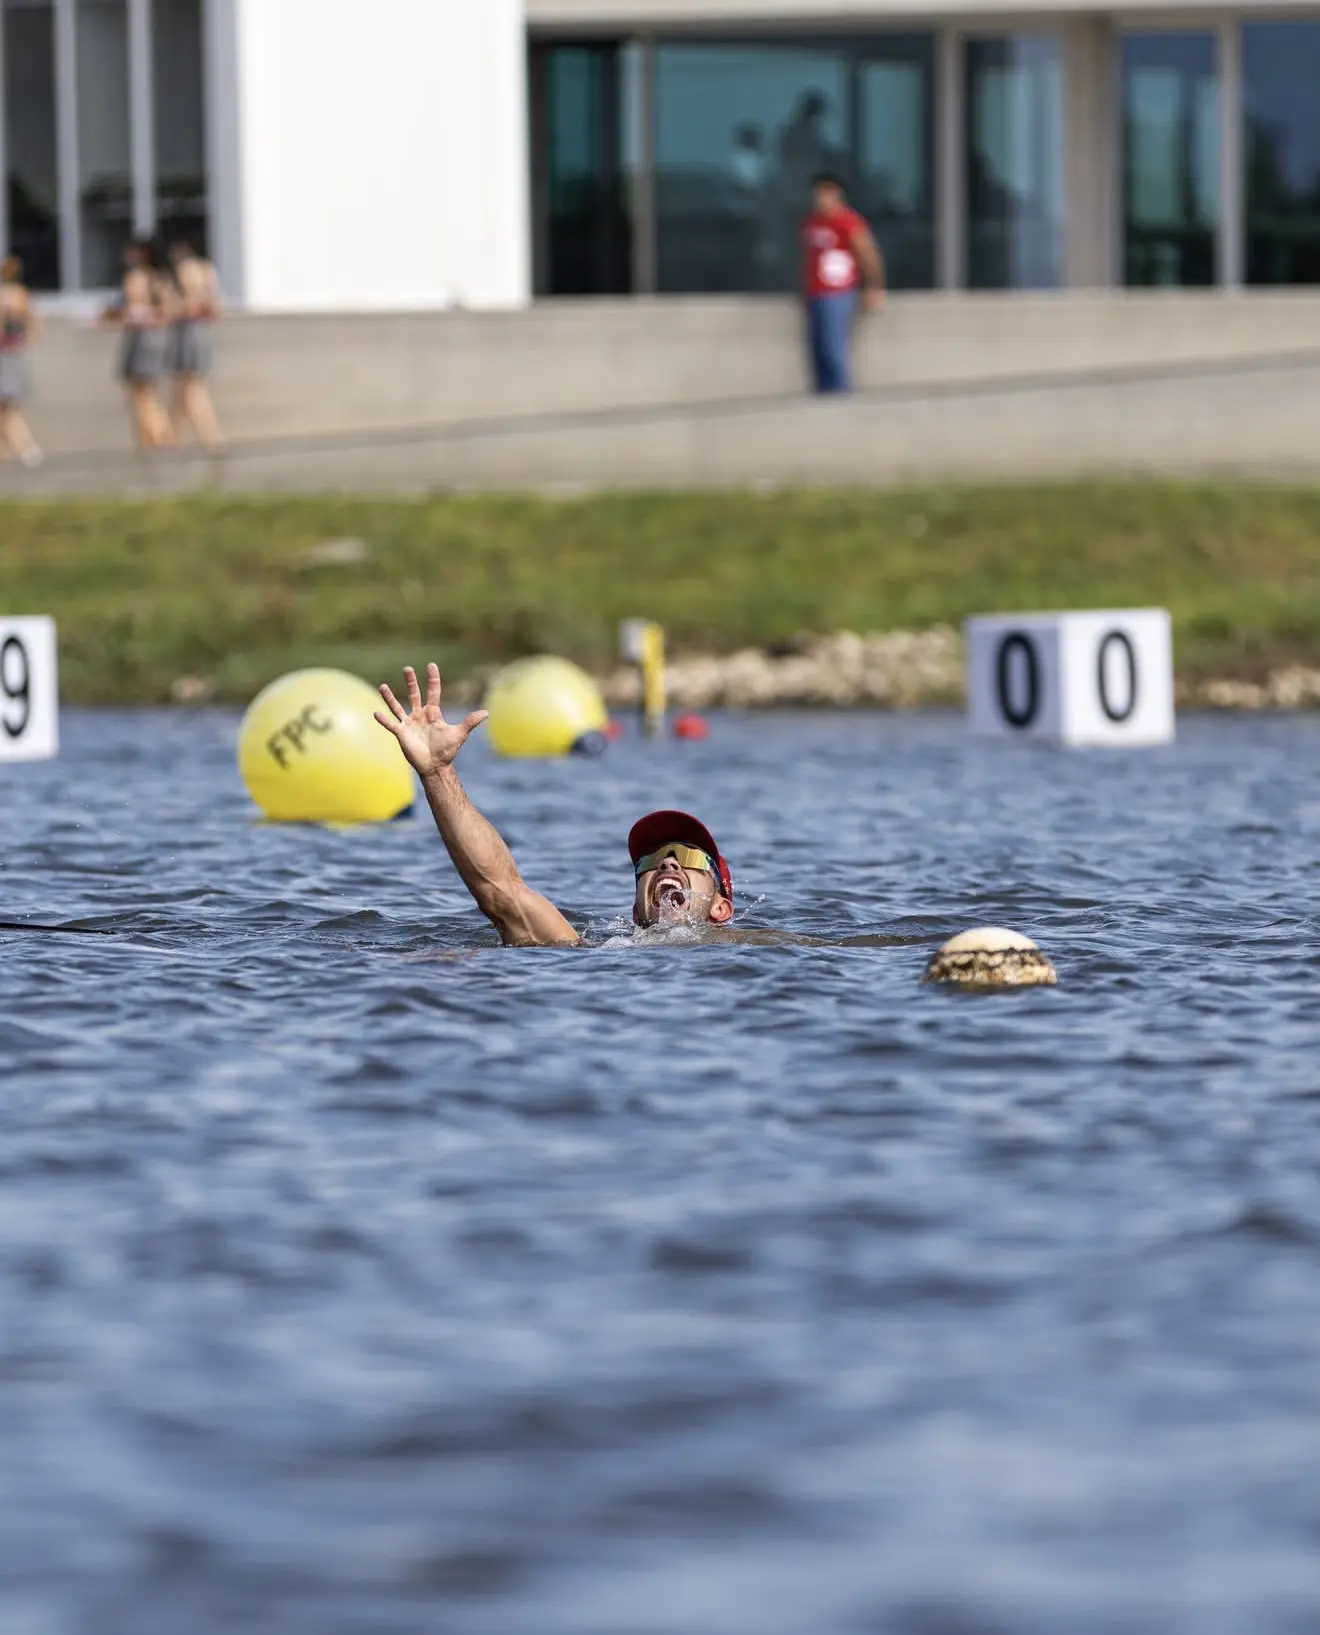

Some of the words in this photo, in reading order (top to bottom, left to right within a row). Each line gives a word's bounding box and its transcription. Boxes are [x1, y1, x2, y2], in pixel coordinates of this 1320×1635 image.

[0, 636, 30, 738] 9
[997, 631, 1041, 728] 0
[1097, 630, 1136, 722] 0
[266, 704, 333, 768] FPC
